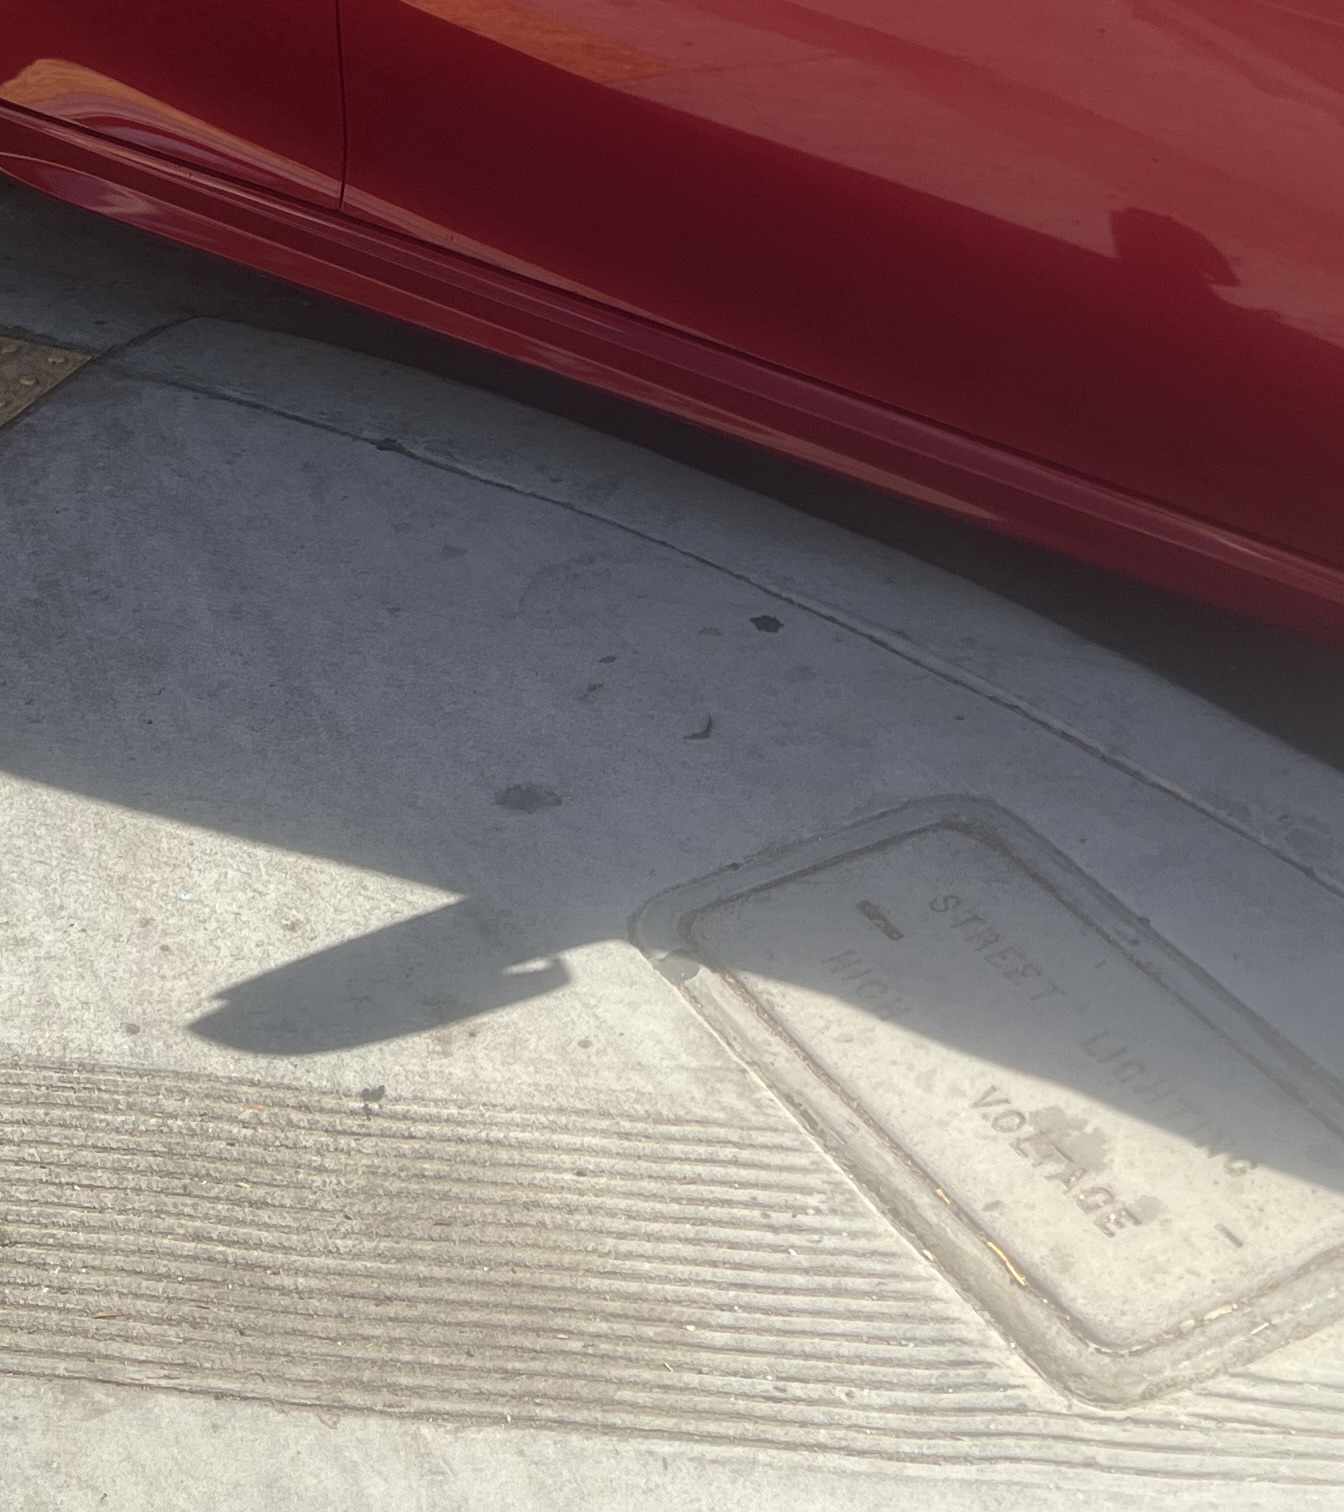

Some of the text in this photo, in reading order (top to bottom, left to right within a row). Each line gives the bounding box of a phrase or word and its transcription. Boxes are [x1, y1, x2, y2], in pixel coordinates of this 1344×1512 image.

[821, 946, 1143, 1239] HIGH VOLTAGE
[928, 893, 1258, 1179] STREET LIGHTING
